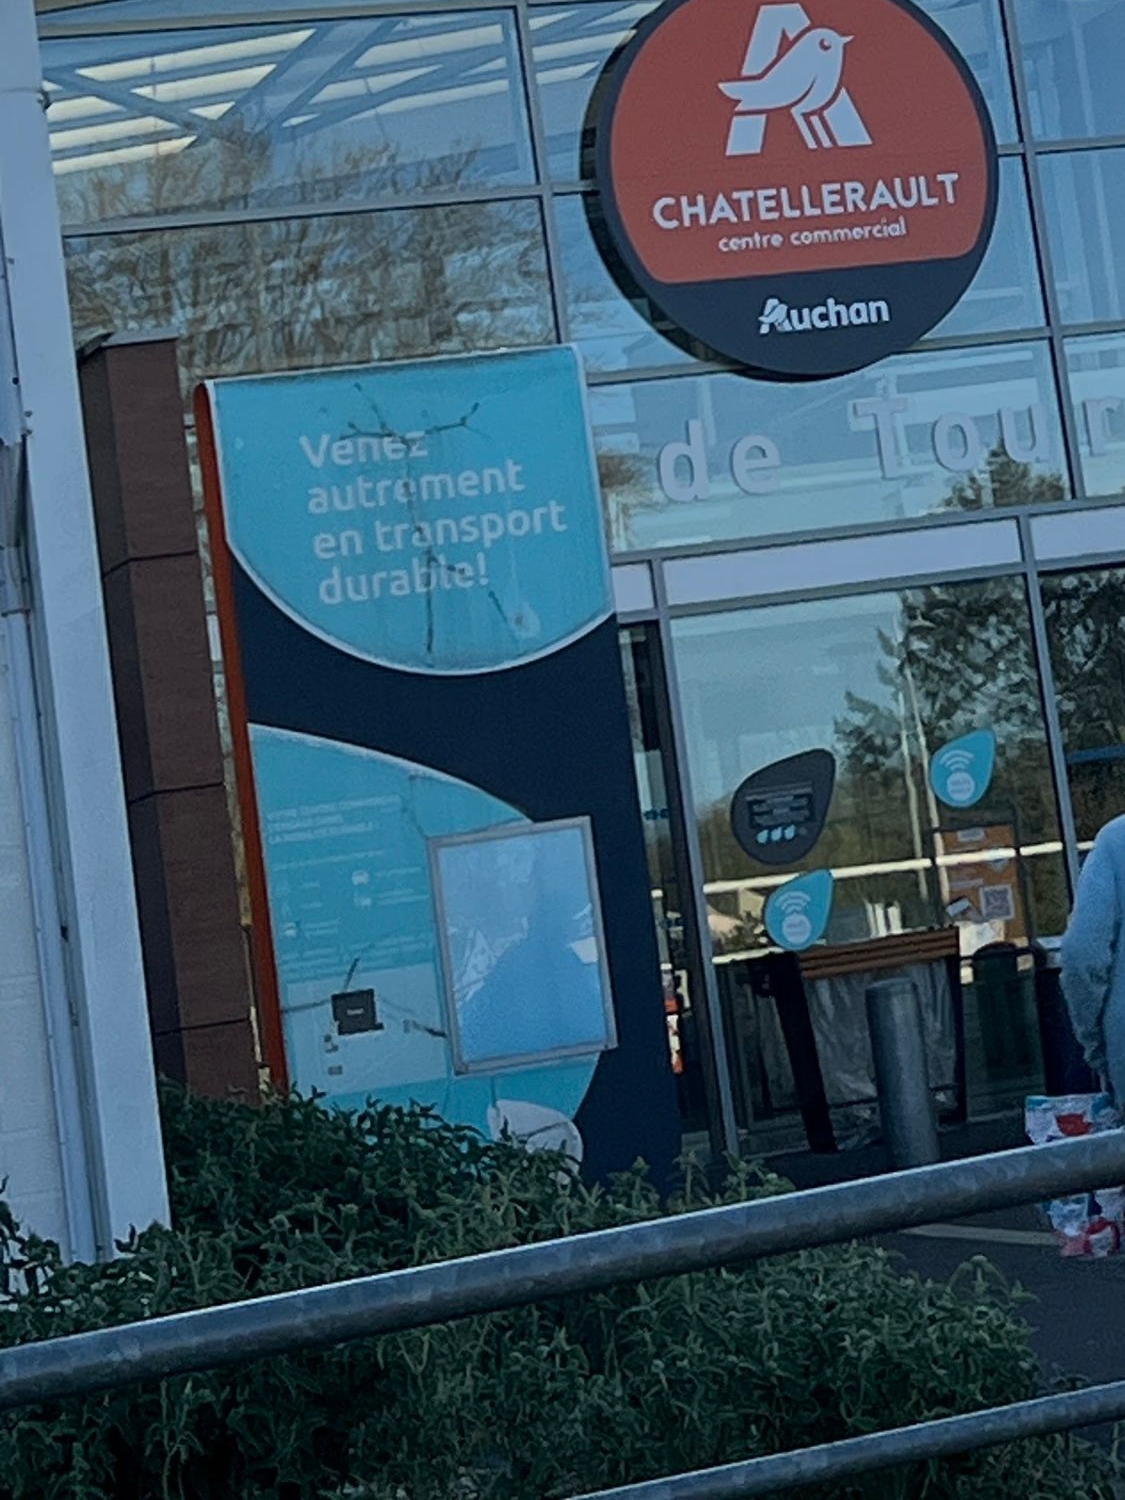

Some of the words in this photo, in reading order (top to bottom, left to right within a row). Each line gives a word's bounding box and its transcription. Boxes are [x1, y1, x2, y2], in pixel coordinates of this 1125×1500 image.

[652, 173, 959, 230] CHATELLERAULT
[718, 231, 784, 253] centre
[790, 216, 907, 245] commercial
[758, 297, 891, 335] Auchan
[300, 430, 429, 468] Venez
[656, 419, 782, 501] de
[307, 458, 525, 515] autrement
[313, 529, 364, 559] en
[374, 500, 567, 552] transport
[318, 551, 490, 605] durable!
